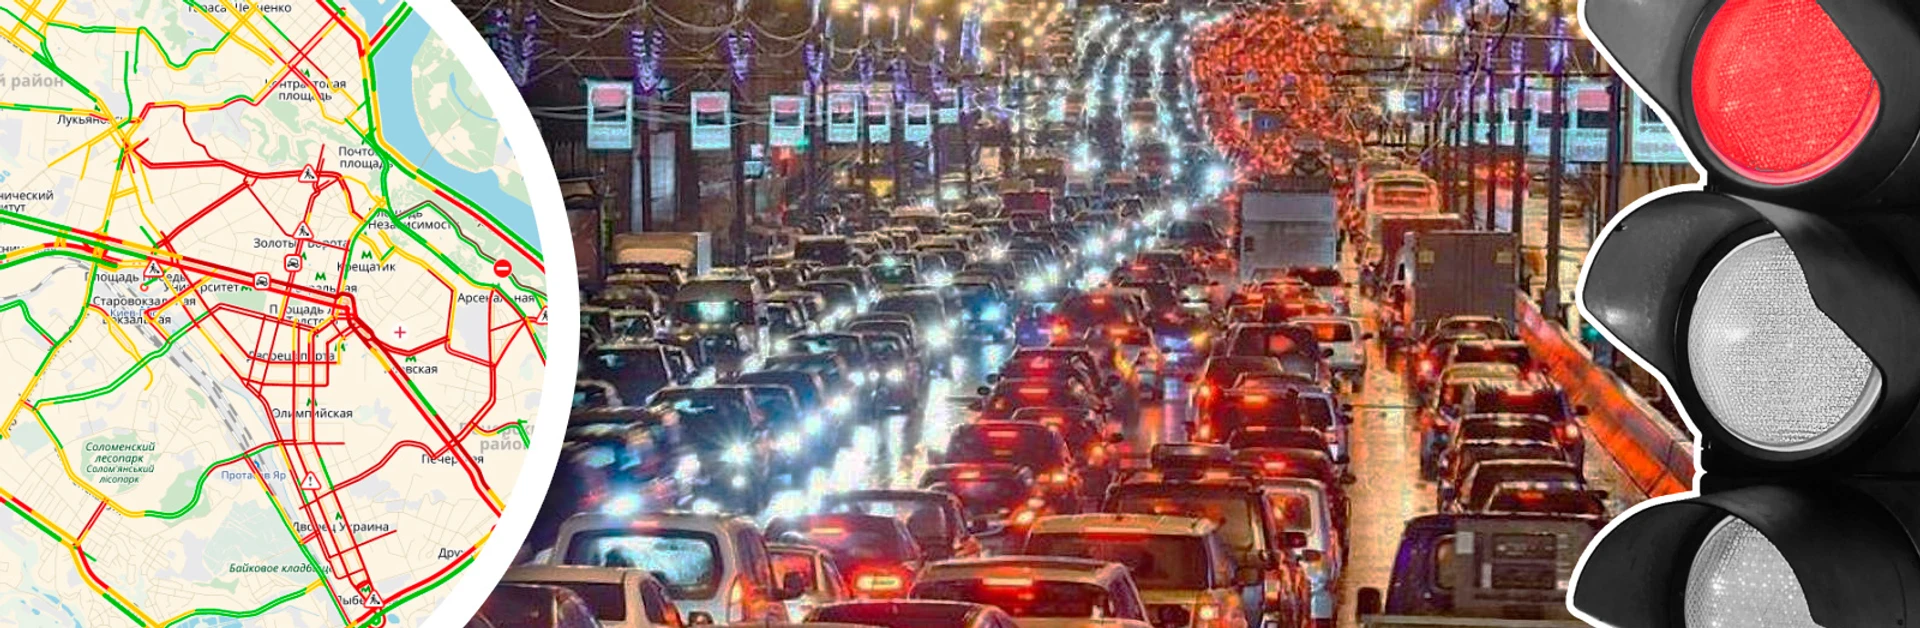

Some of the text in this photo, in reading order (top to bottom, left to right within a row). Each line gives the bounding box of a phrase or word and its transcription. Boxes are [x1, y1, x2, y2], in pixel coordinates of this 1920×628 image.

[11, 73, 64, 91] район
[85, 441, 156, 452] Соломенский
[94, 454, 144, 465] лесопарк
[86, 464, 155, 473] Солом'янський
[98, 475, 140, 486] лісопарк
[273, 470, 287, 482] Яр
[229, 563, 279, 573] Байковое
